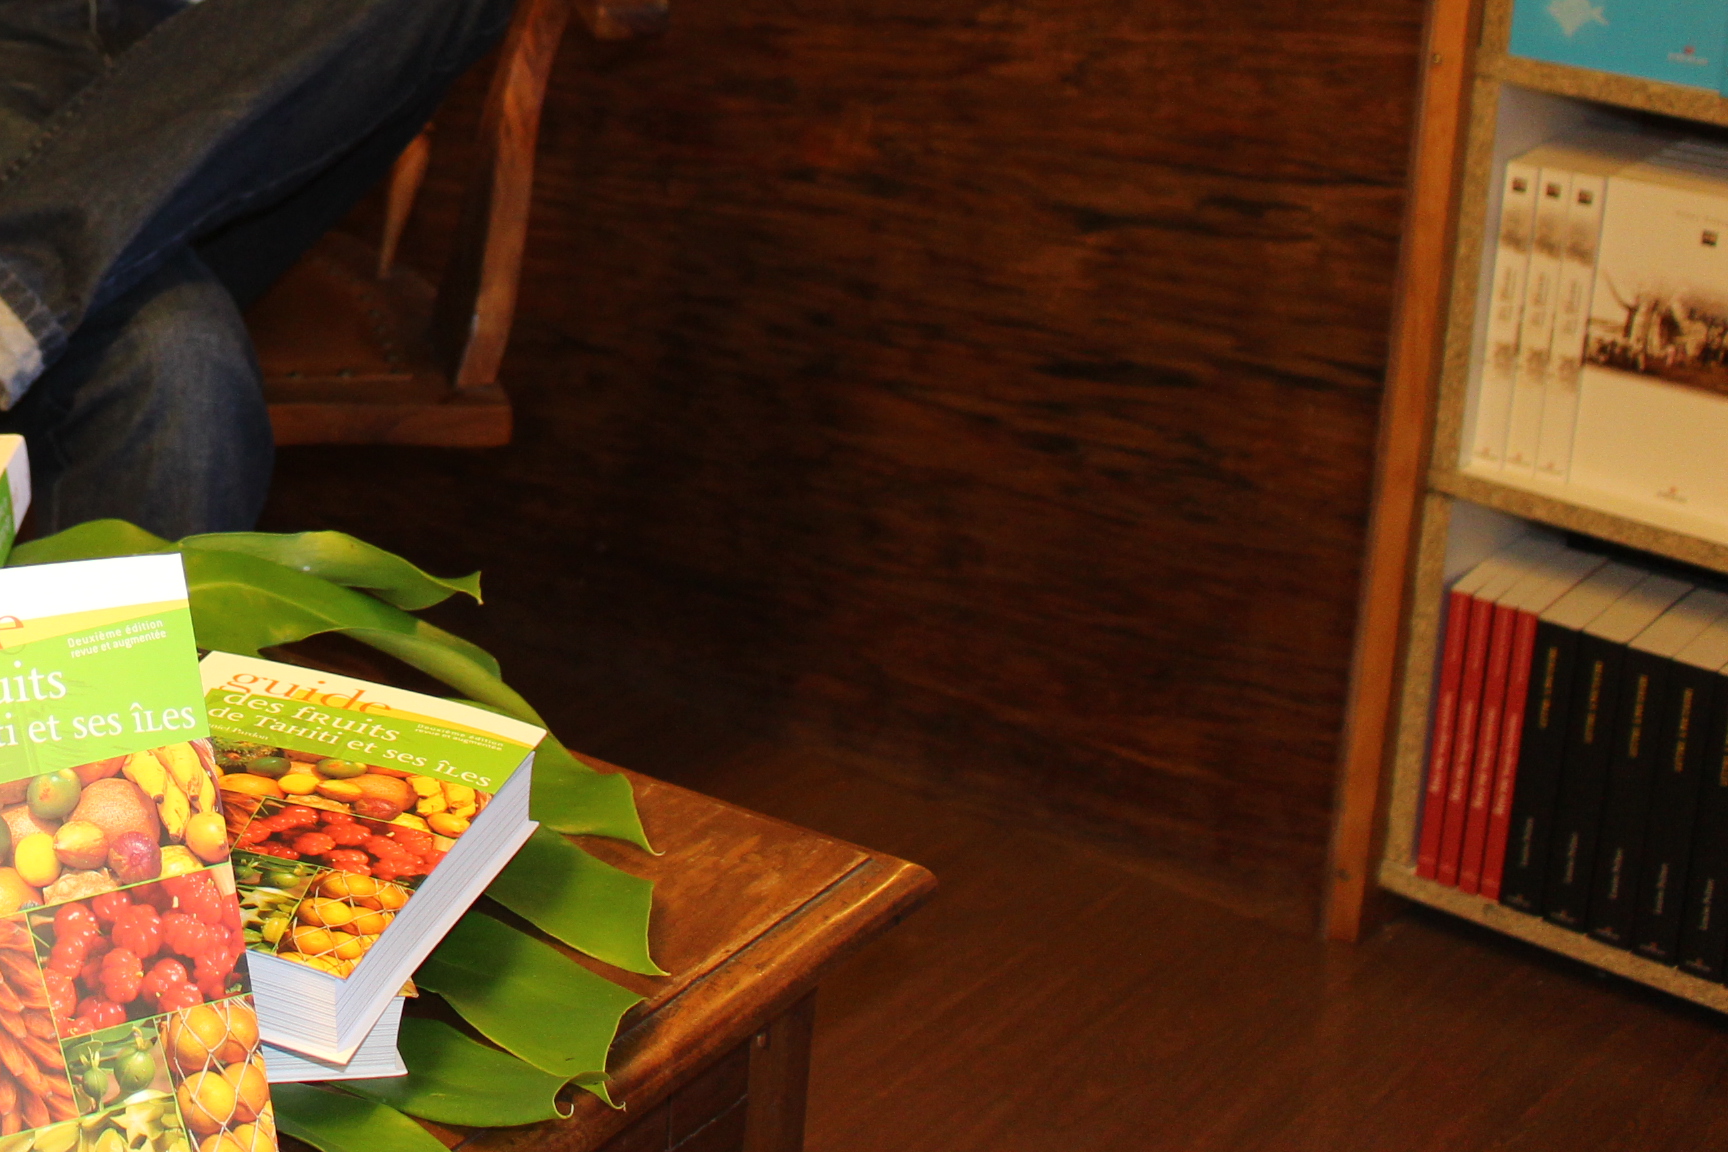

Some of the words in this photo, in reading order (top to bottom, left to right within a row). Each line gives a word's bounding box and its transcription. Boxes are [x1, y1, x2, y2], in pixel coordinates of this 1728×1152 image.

[67, 629, 123, 648] Deuxième
[125, 619, 164, 635] édition
[70, 645, 99, 659] revue
[100, 641, 112, 652] et
[112, 629, 167, 649] augmentée
[218, 673, 392, 713] guide
[223, 692, 285, 715] des
[27, 715, 63, 744] et
[72, 711, 123, 741] ses
[208, 707, 245, 723] de
[346, 739, 379, 755] et
[382, 746, 428, 769] ses
